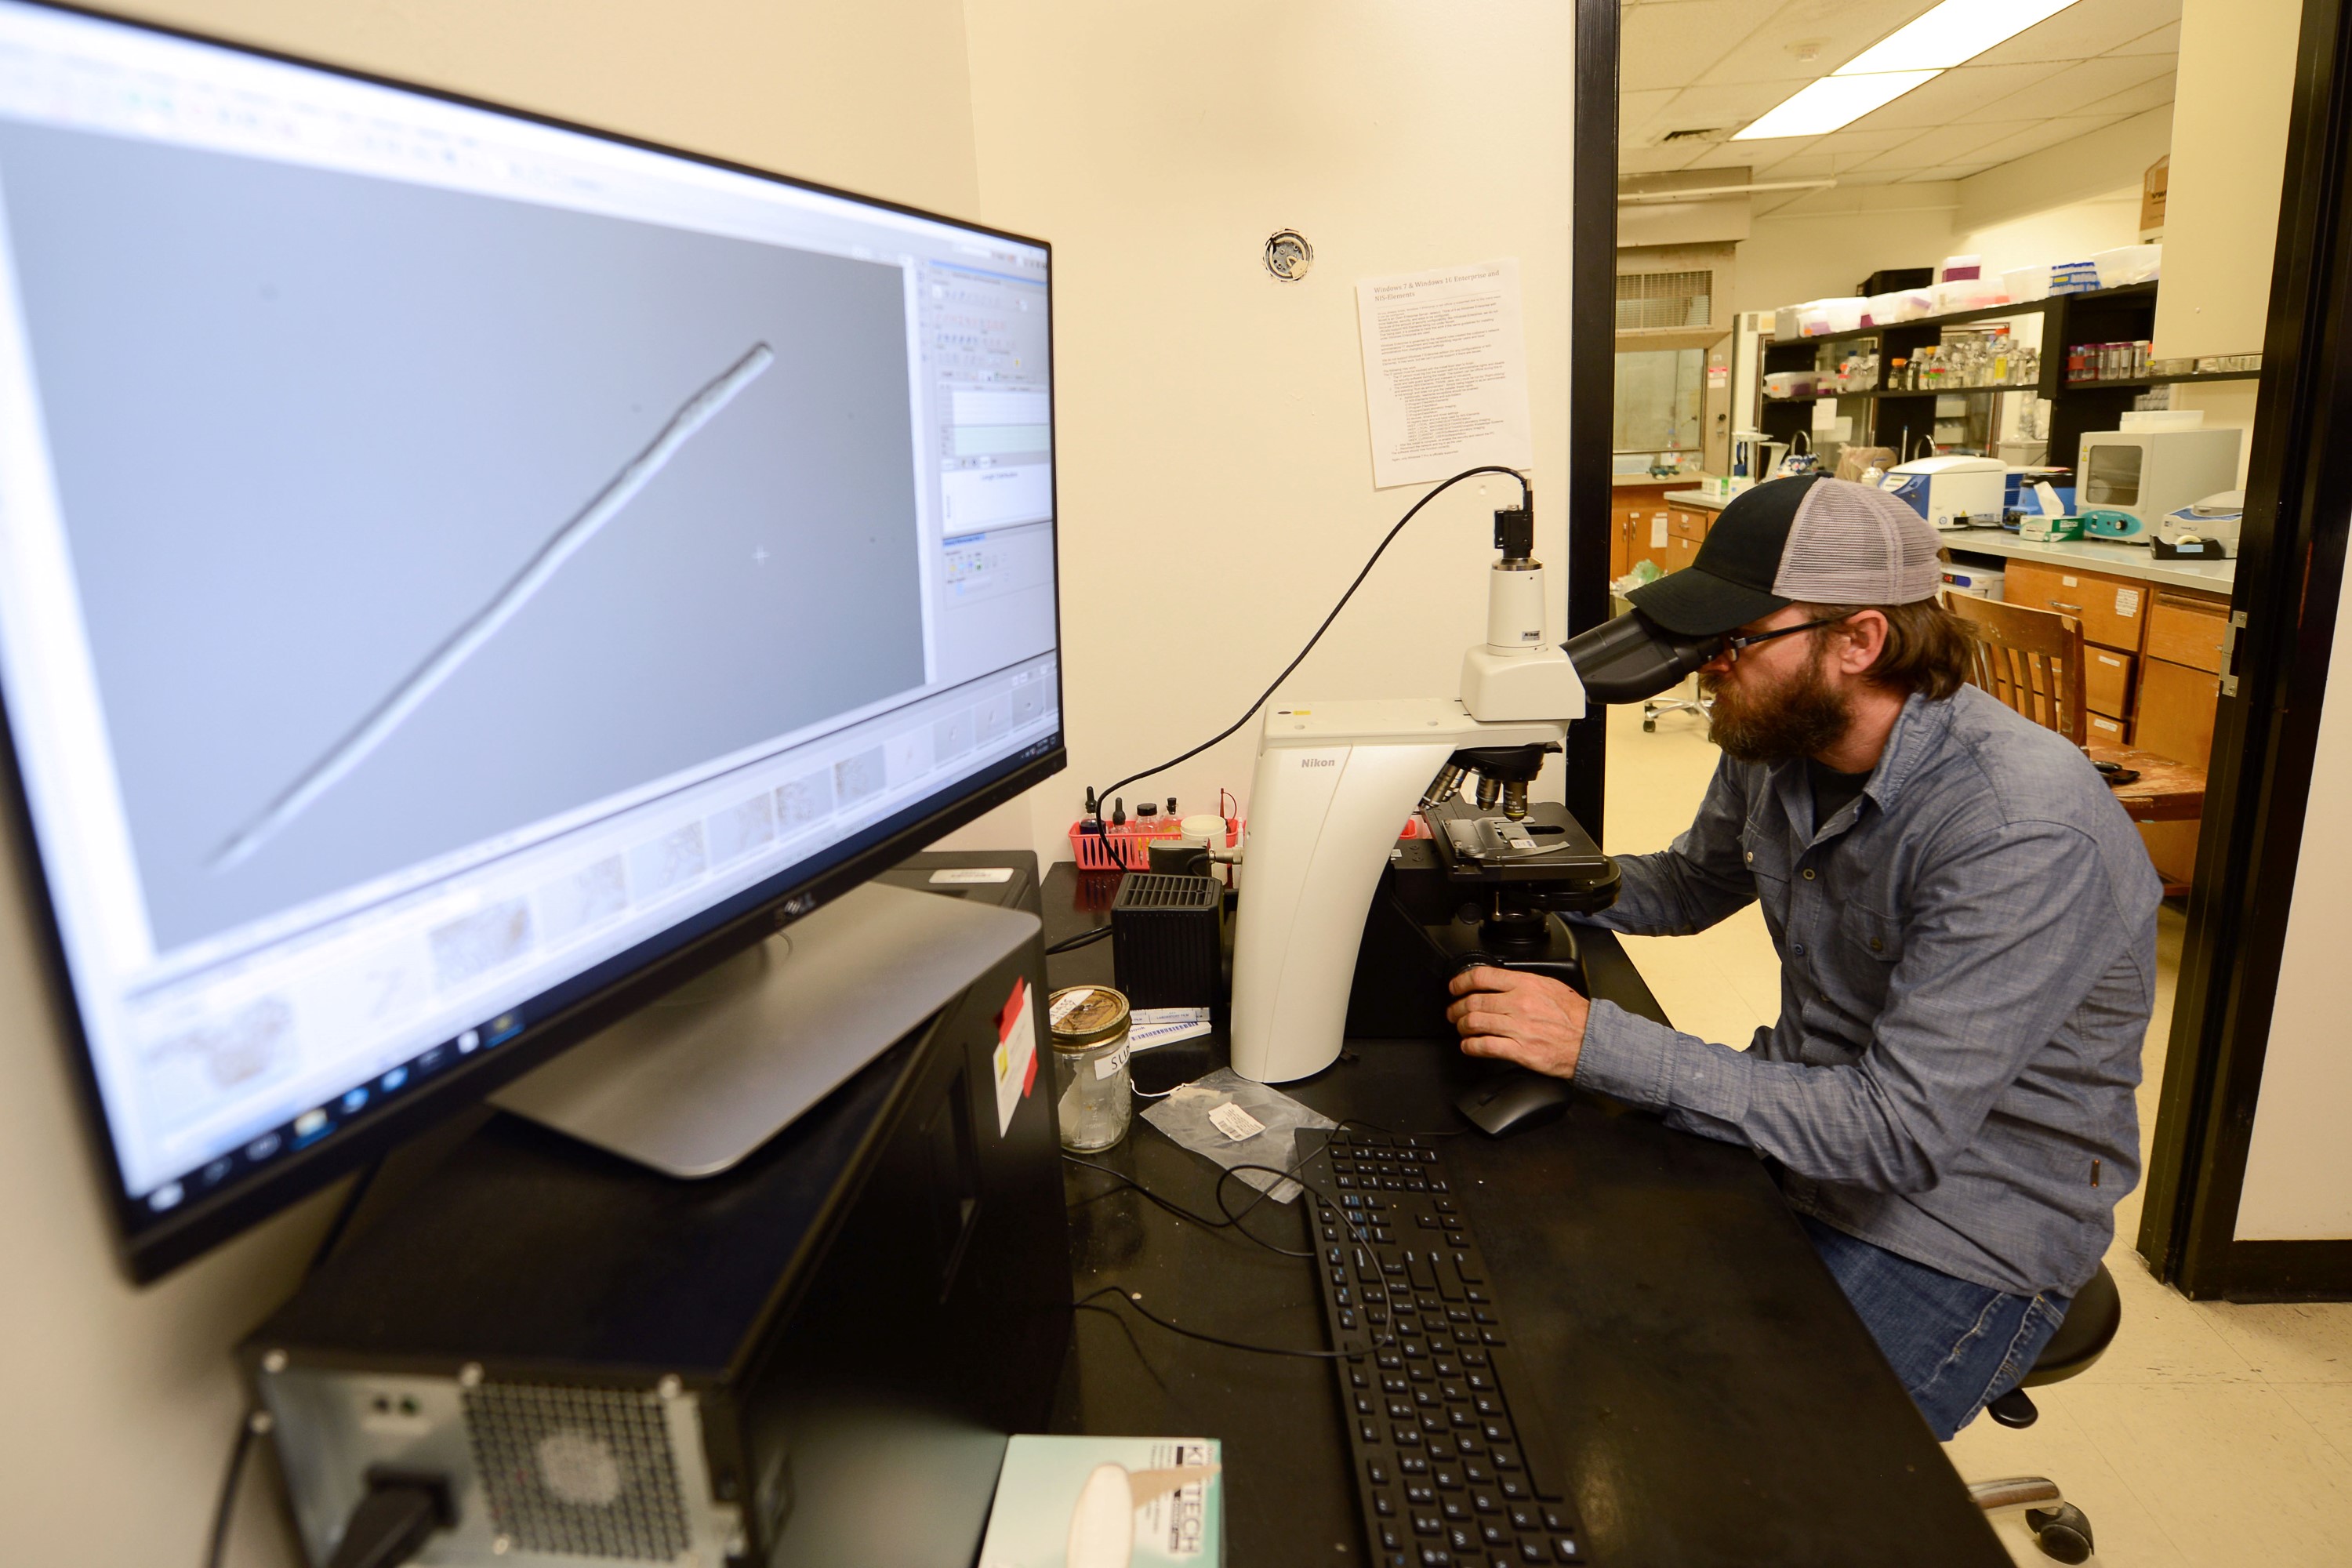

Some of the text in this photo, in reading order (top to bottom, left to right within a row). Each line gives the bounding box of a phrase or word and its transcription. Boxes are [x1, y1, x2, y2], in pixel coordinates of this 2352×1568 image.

[1374, 284, 1402, 293] Windows
[1414, 278, 1443, 288] Windows
[1454, 272, 1486, 283] Enterprise
[1374, 292, 1415, 302] NIS-Elements
[1301, 758, 1335, 768] Nikon
[1182, 1446, 1203, 1552] KITECH
